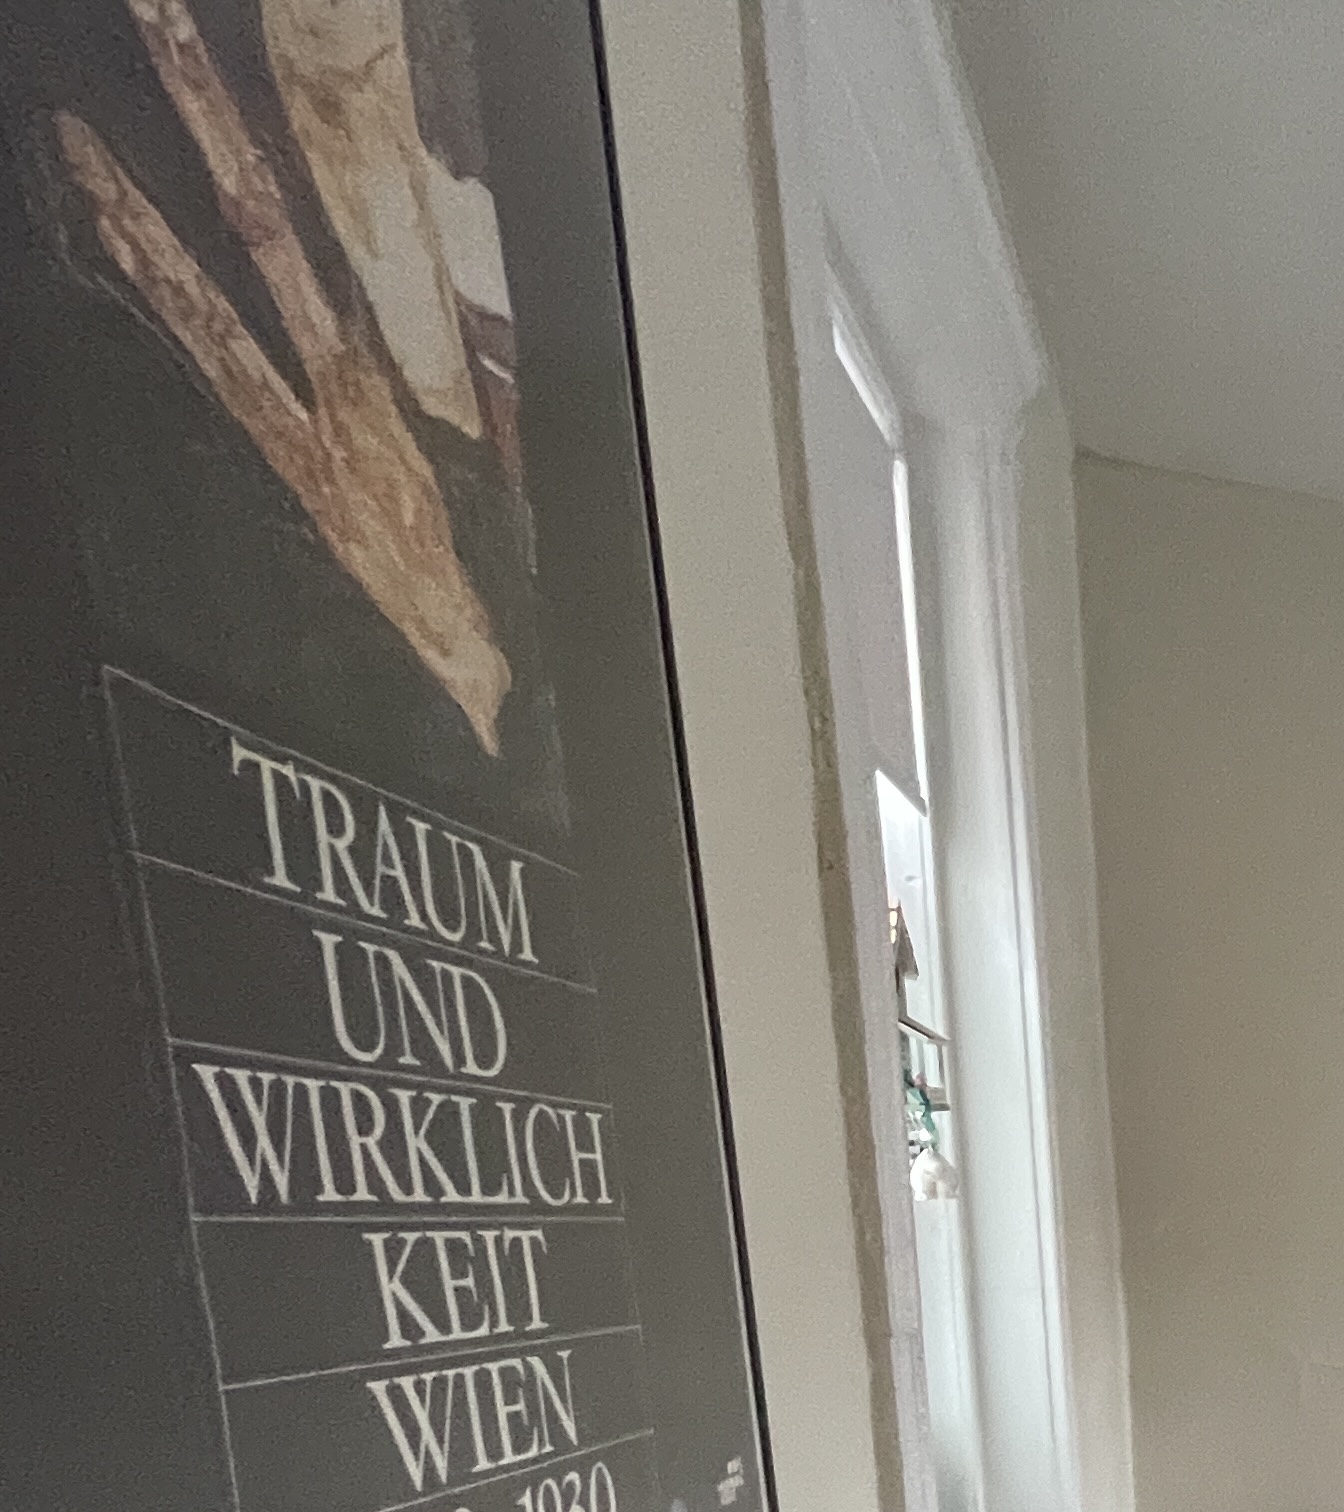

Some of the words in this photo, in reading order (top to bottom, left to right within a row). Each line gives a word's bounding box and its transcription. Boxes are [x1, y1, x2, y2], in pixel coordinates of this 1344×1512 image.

[231, 736, 539, 965] TRAUM
[312, 930, 508, 1078] UND
[191, 1064, 614, 1207] WIRKLICH
[363, 1228, 549, 1349] KEIT
[366, 1350, 580, 1492] WIEN
